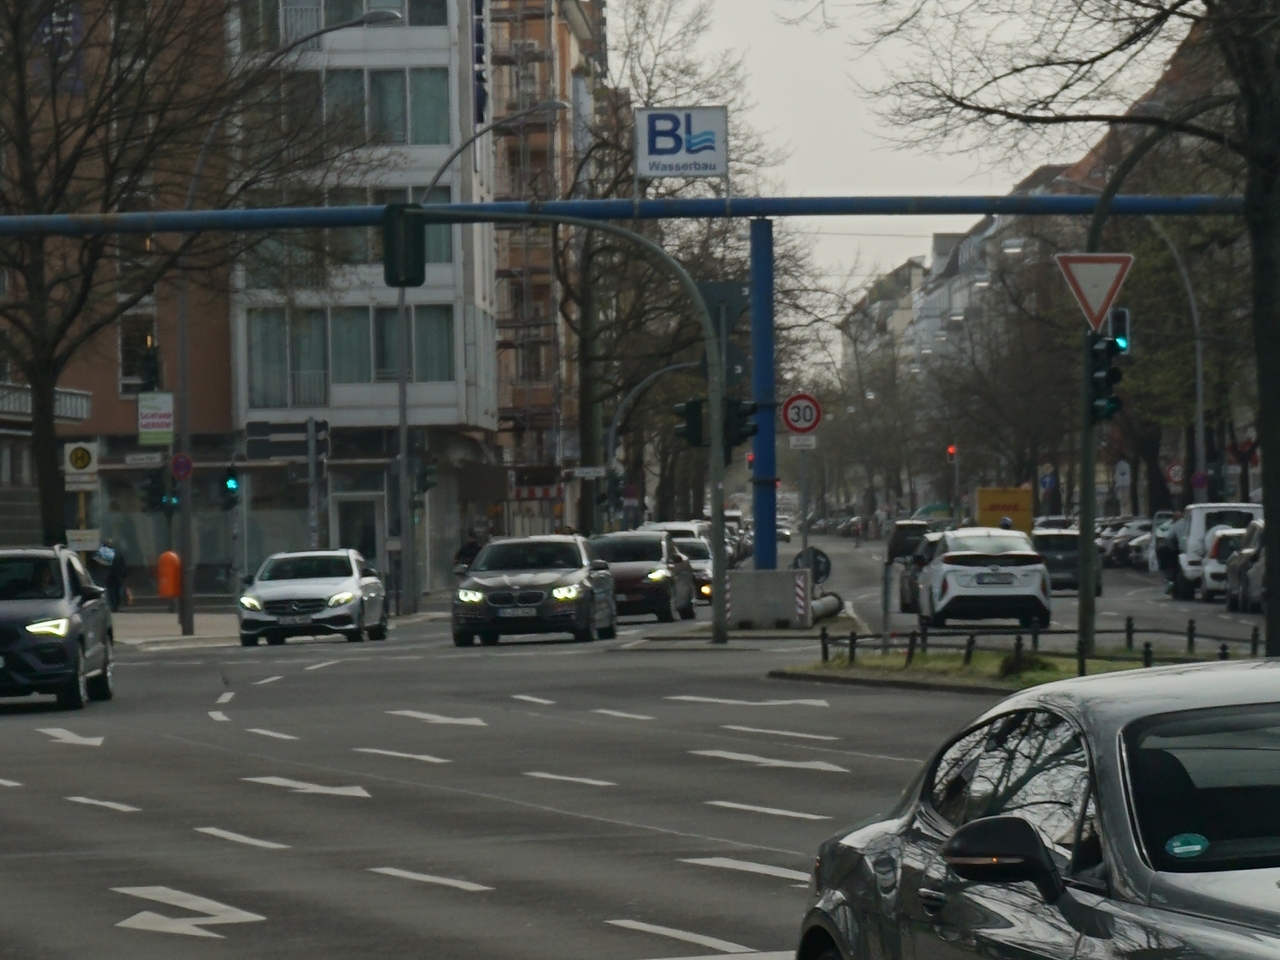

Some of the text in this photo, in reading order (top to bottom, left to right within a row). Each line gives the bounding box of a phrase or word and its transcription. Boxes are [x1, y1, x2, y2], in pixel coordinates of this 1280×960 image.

[647, 112, 716, 156] BL
[649, 161, 718, 172] Wasserbau
[790, 405, 814, 423] 30
